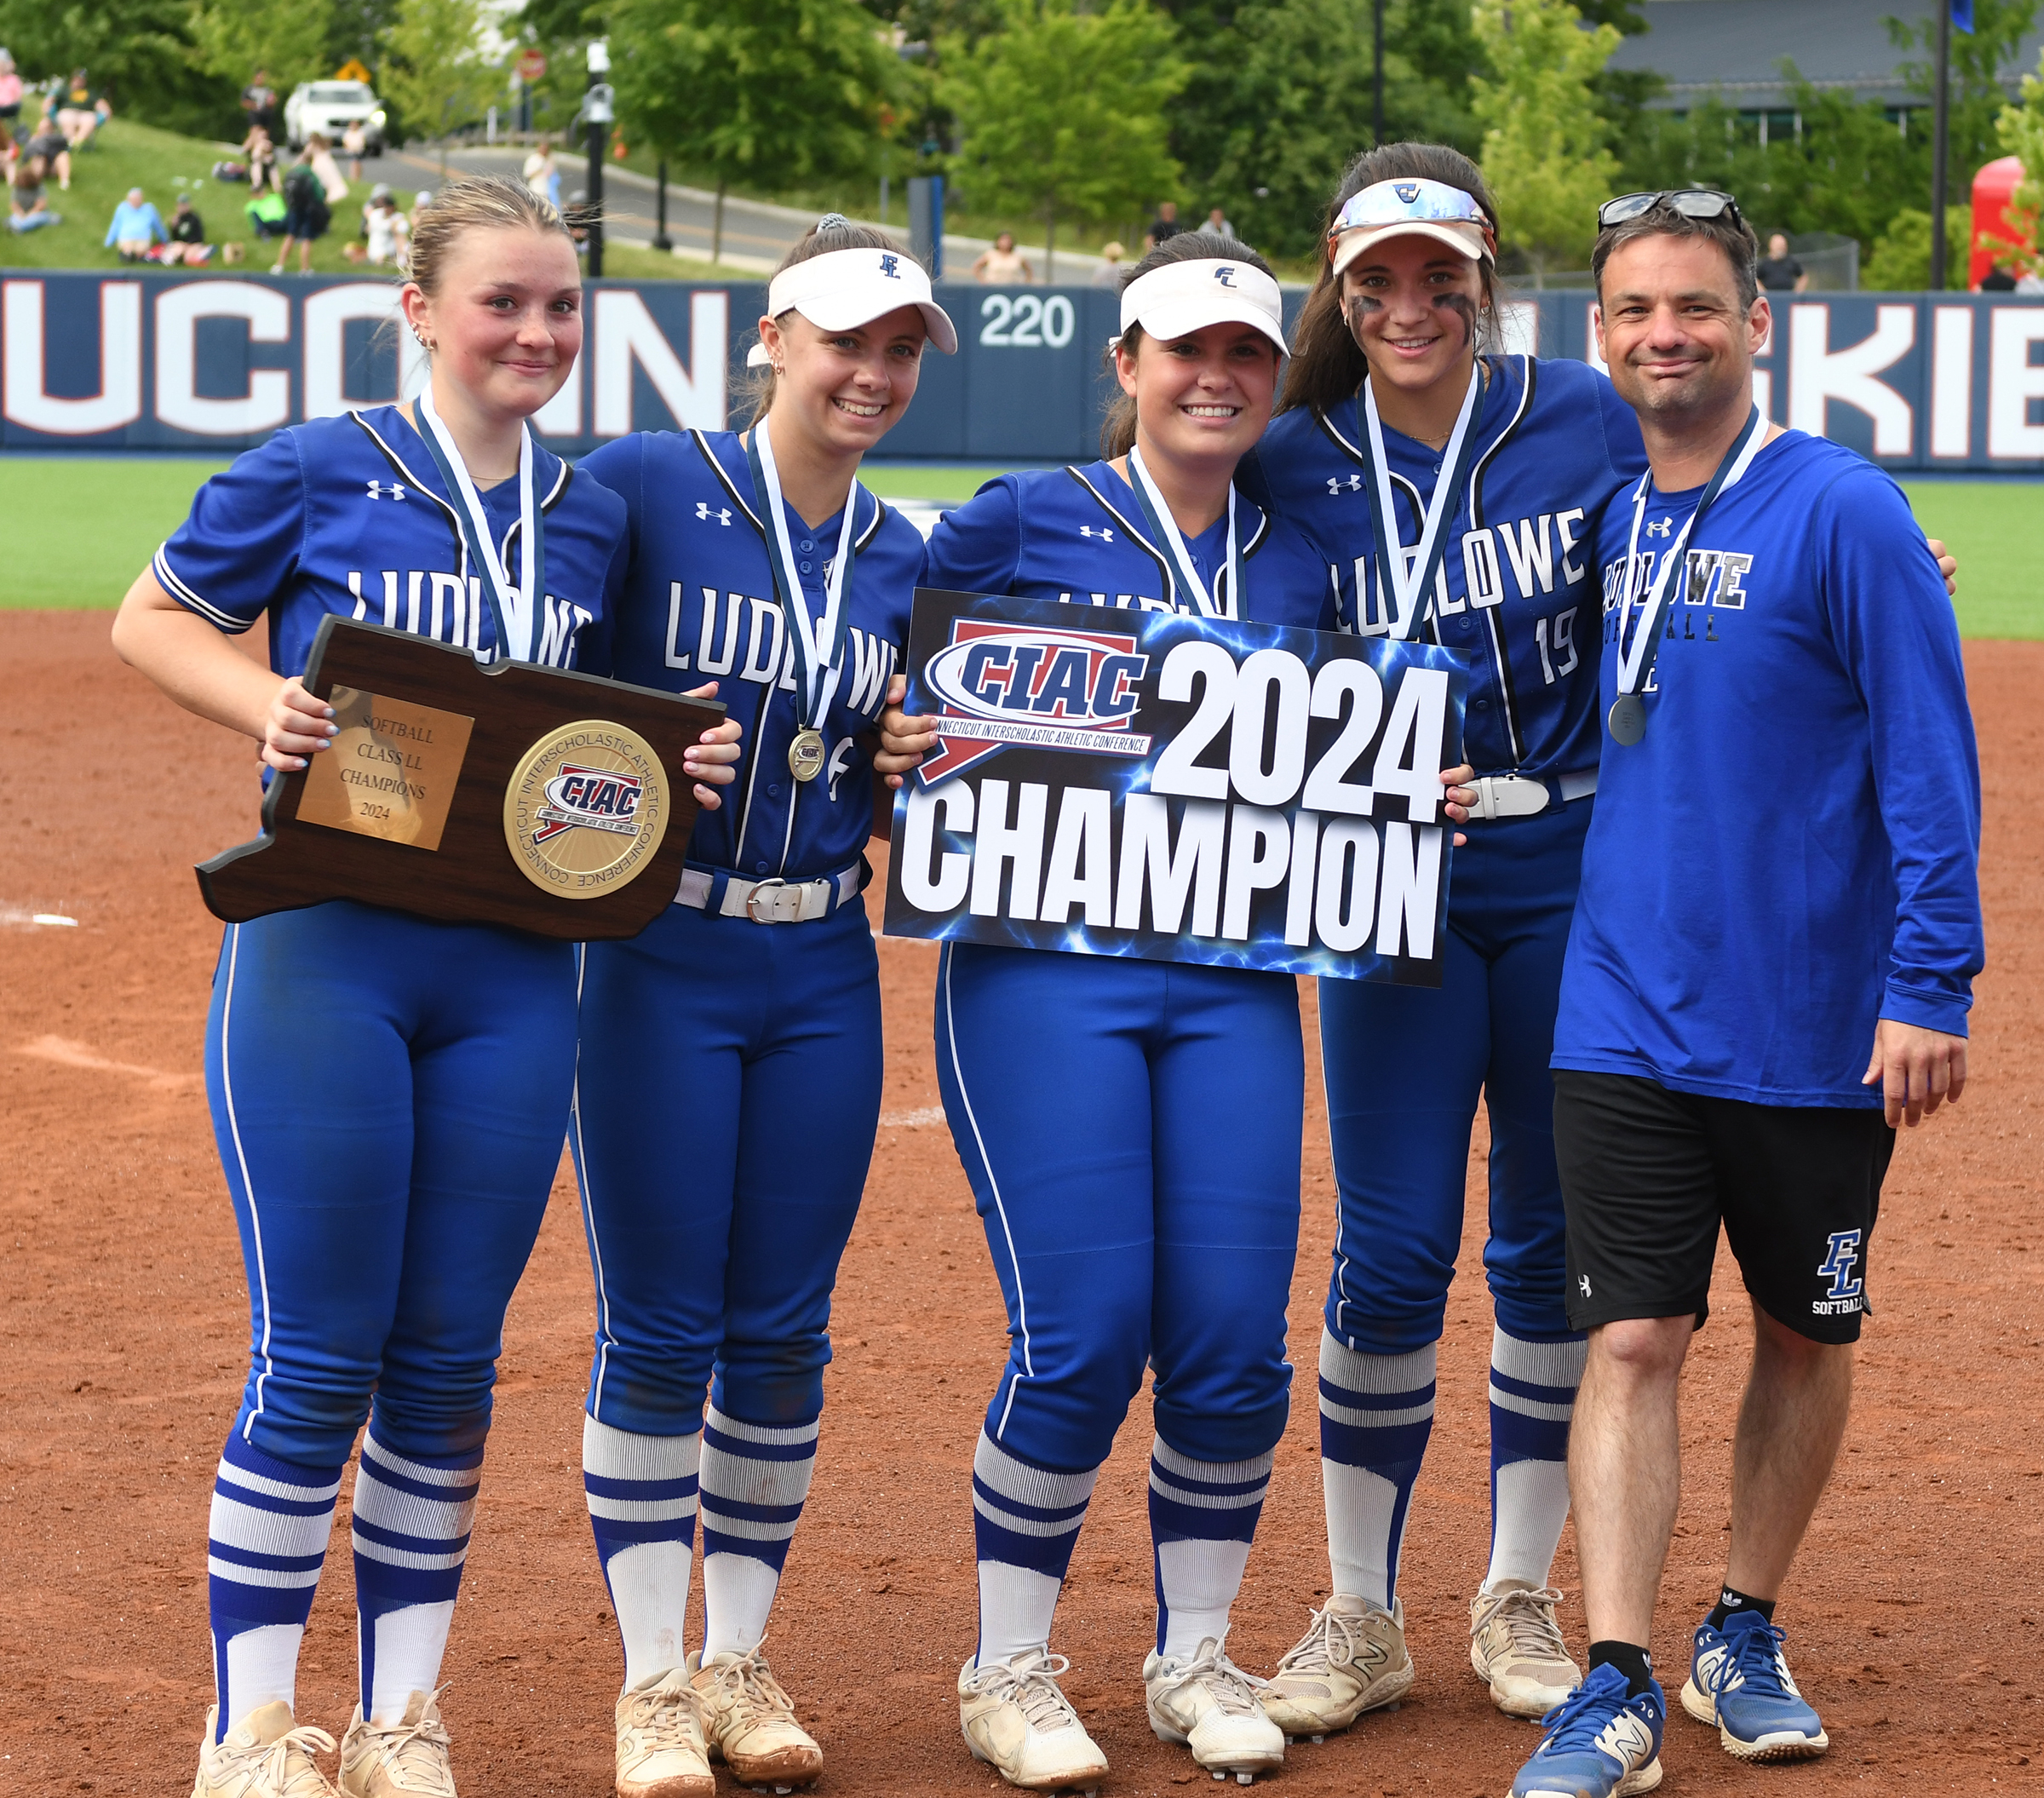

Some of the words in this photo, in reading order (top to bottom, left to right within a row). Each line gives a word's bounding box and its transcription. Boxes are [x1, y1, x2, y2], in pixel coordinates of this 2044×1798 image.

[979, 293, 1075, 348] 220
[1535, 606, 1579, 685] 19
[961, 641, 1150, 717] CIAC
[357, 743, 403, 766] CLASS
[405, 754, 422, 770] LL
[361, 715, 433, 744] SOFTBALL
[935, 720, 982, 737] NNECTICUT
[982, 724, 1054, 744] INTERSCHOLASTIC
[1054, 732, 1093, 747] ATHLETIC
[1093, 735, 1145, 752] CONFERENCE
[1150, 640, 1449, 824] 2024
[340, 768, 426, 800] CHAMPIONS
[522, 733, 633, 795] INTERSCHOLASTIC
[631, 755, 659, 819] ATHLETIC
[360, 801, 390, 820] 2024
[561, 777, 642, 815] CIAC
[516, 797, 568, 884] CONNECTICUT
[577, 824, 654, 887] CONFERENCE
[899, 778, 1444, 960] CHAMPION
[1817, 1228, 1863, 1300] FL
[1812, 1297, 1863, 1315] SOFTBALL
